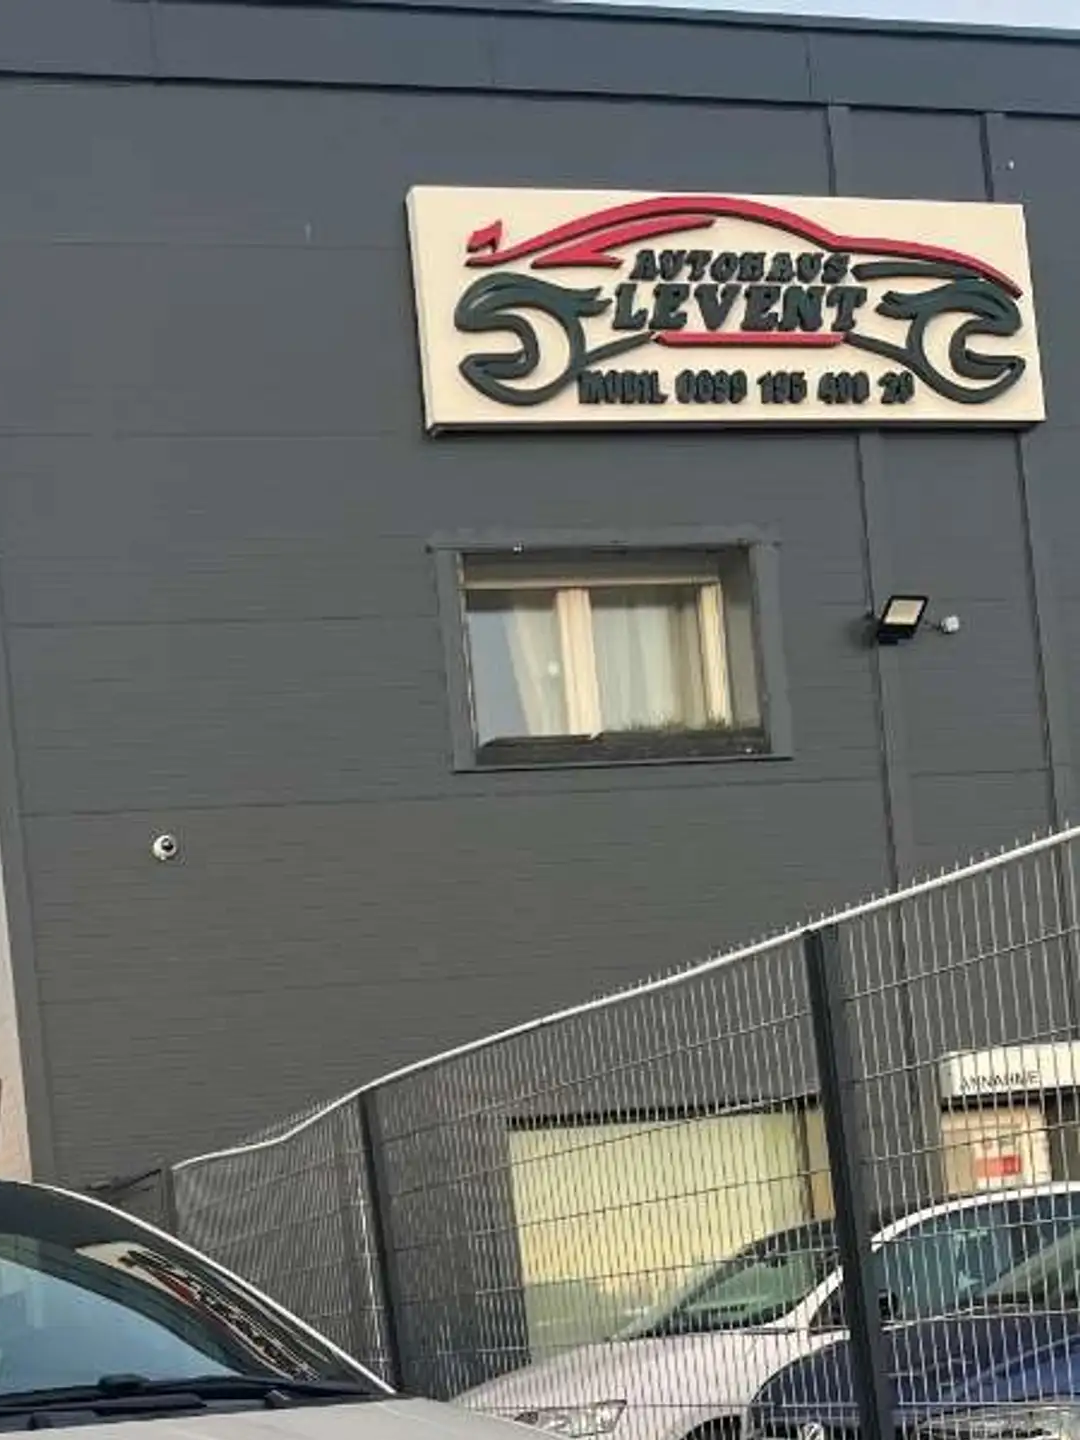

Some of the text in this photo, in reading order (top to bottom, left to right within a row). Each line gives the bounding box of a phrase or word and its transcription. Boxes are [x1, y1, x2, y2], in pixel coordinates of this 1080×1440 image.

[629, 249, 851, 283] AUTOHAUS
[612, 282, 868, 332] LEVENT
[579, 371, 668, 404] MOBIL
